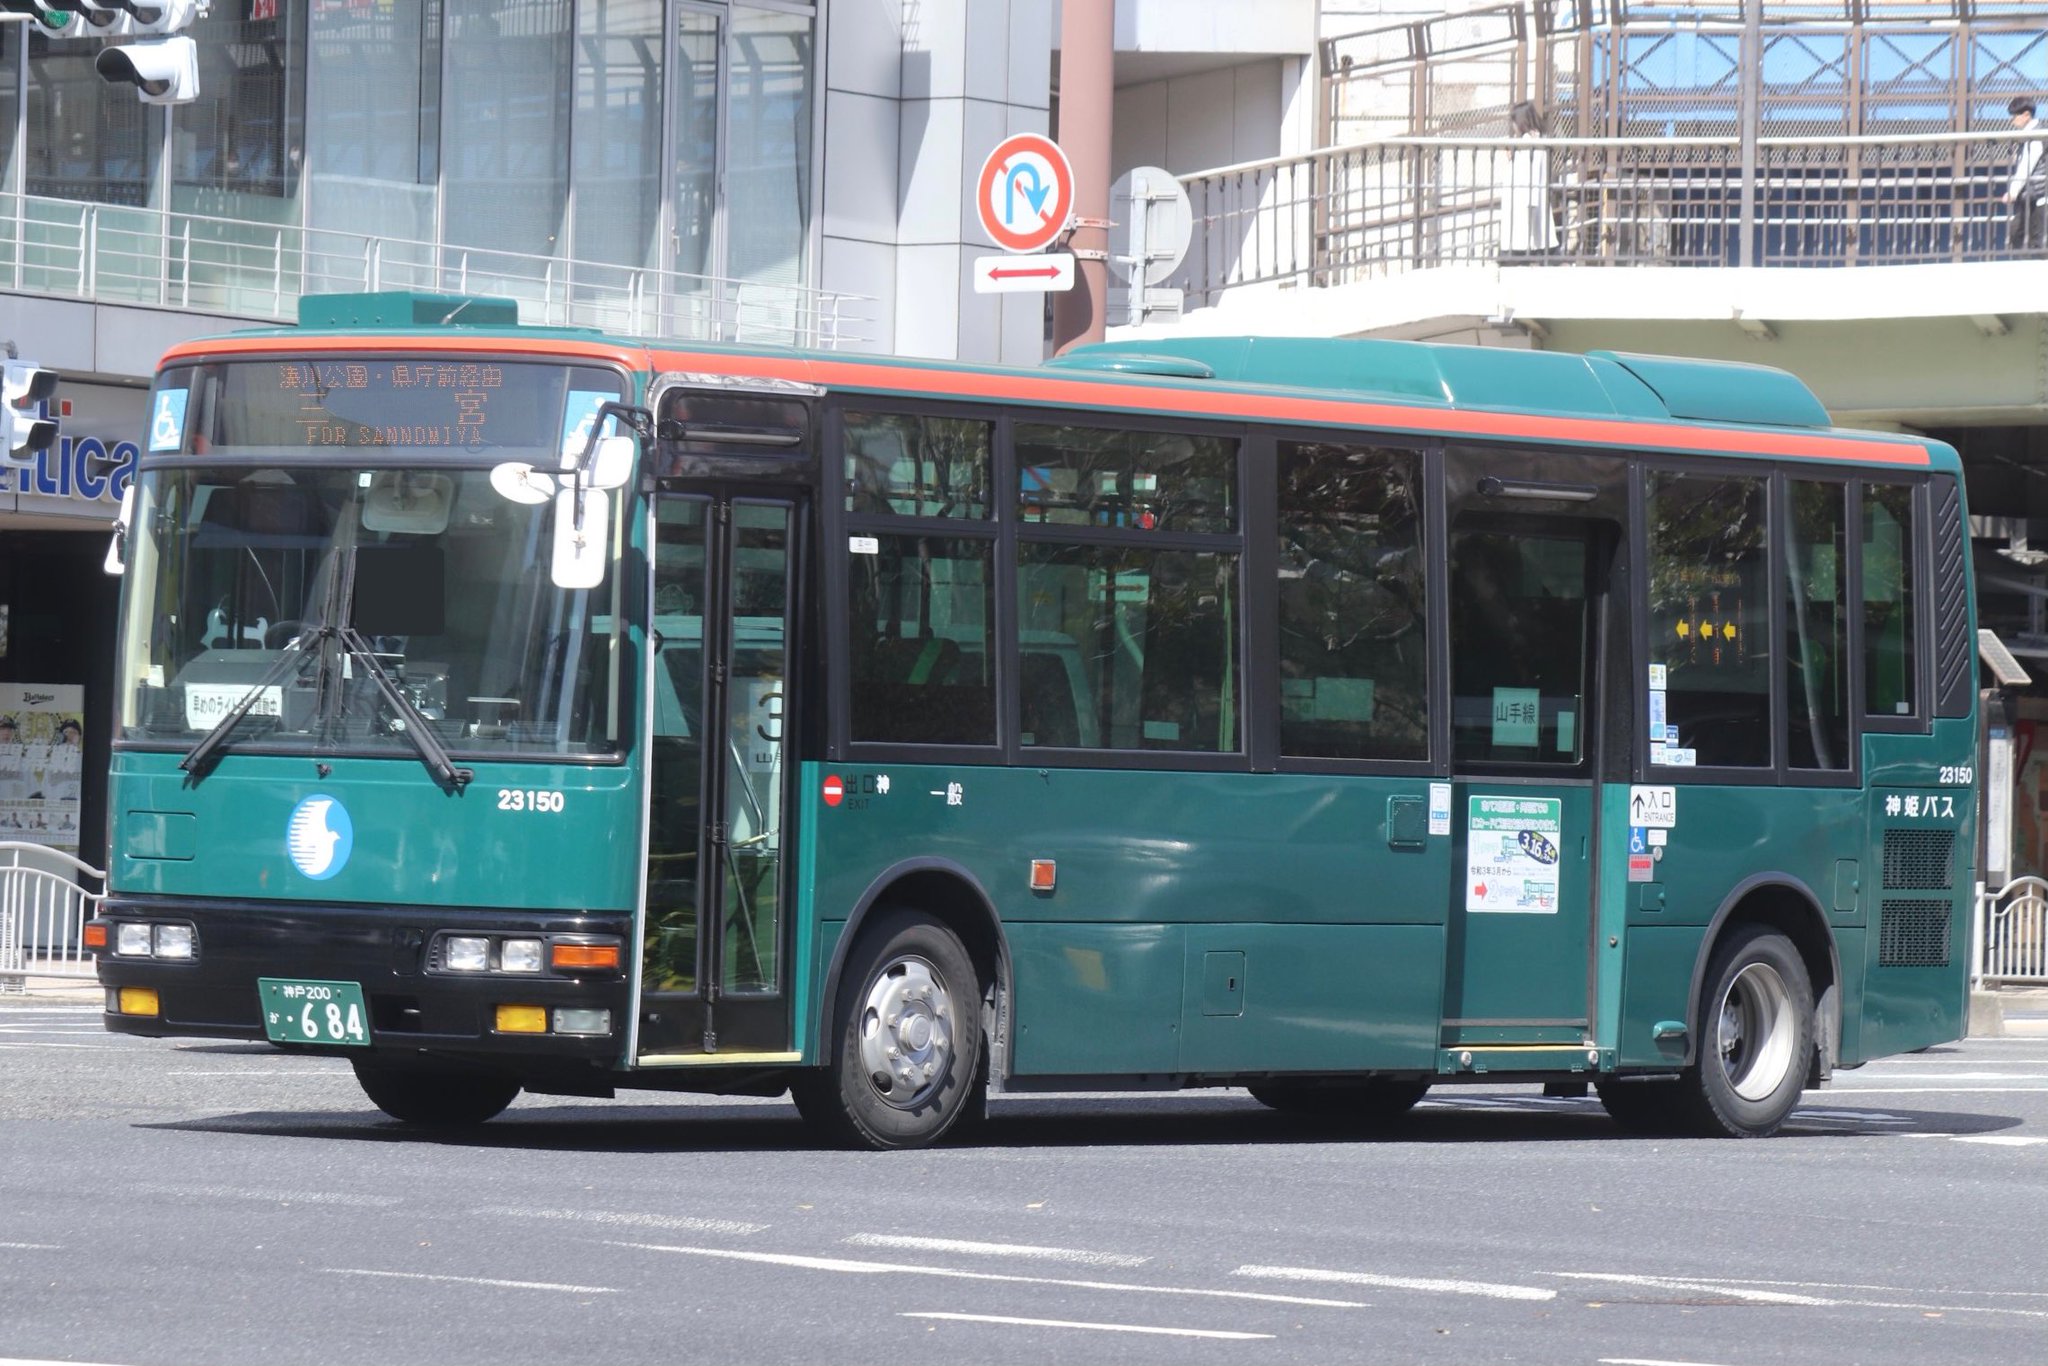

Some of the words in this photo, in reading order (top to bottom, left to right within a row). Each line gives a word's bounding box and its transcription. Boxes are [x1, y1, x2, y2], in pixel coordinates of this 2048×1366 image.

[307, 426, 347, 445] FOR
[359, 426, 481, 445] SANNOMIYA
[1496, 701, 1535, 725] 山手線
[1939, 766, 1973, 784] 23150
[497, 788, 565, 813] 23150
[1648, 791, 1671, 808] 入口
[1885, 794, 1954, 818] 神姫バス
[1643, 811, 1675, 823] ENTRANCE
[282, 985, 332, 1000] 神戸200
